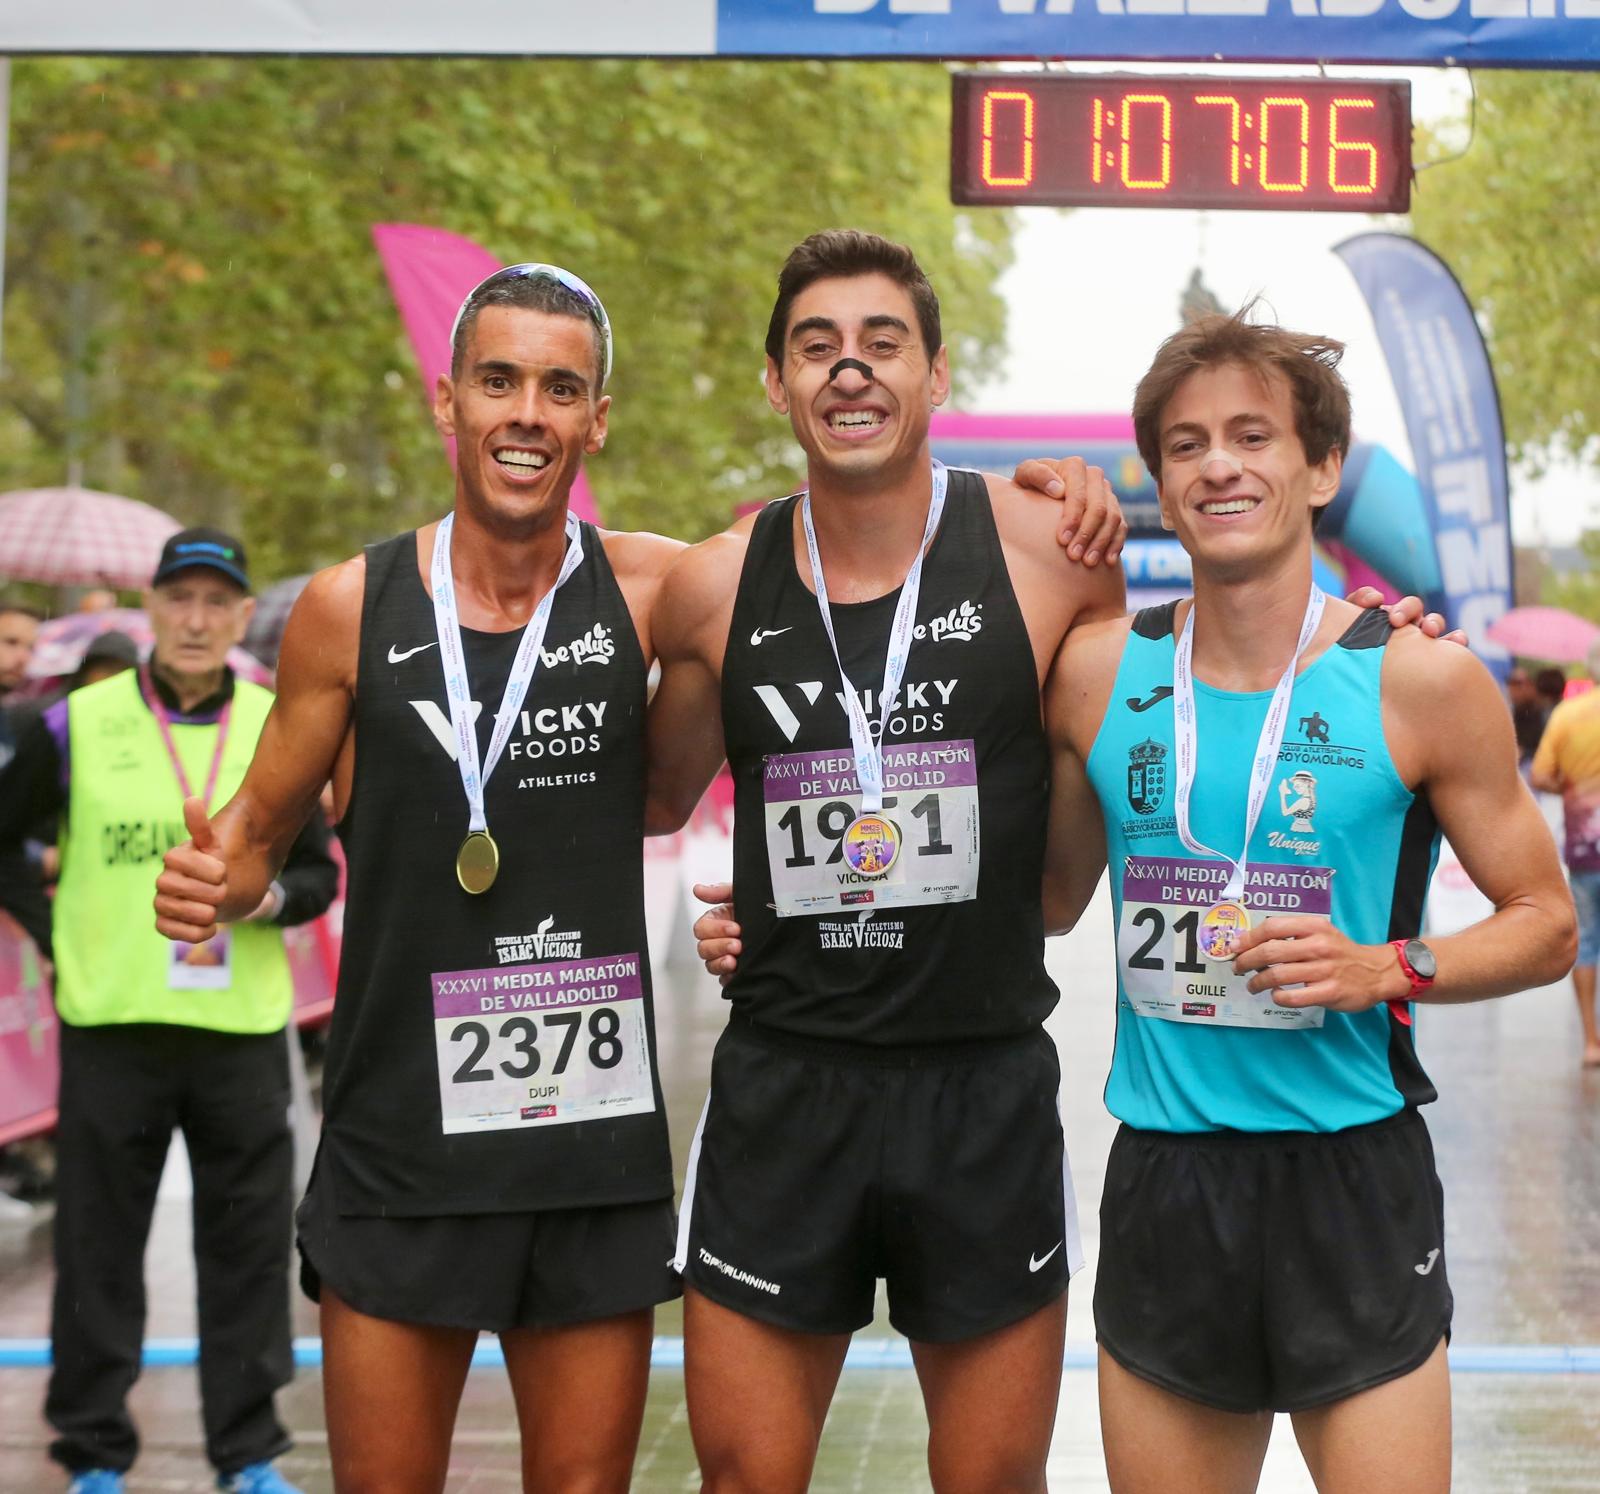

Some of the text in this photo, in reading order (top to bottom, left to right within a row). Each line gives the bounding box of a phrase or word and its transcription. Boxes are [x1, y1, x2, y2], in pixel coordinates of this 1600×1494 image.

[912, 602, 982, 643] e plus
[569, 623, 615, 666] plus
[494, 702, 607, 737] ICKY
[866, 712, 944, 738] OODS
[509, 734, 601, 760] FOODS
[1277, 751, 1365, 769] ROYOMOLINOS
[518, 772, 597, 789] ATHLETICS
[766, 762, 805, 780] XXXVI
[811, 757, 857, 775] MEDI
[799, 769, 946, 796] DE VALDOLID
[778, 793, 953, 868] 191
[1267, 832, 1320, 854] Unique
[1175, 866, 1230, 884] MEDIA
[1162, 886, 1182, 901] DE
[819, 923, 842, 933] ESCUELA
[867, 922, 904, 935] ATLETISMO
[820, 923, 904, 949] ISAAC VICIOSA
[1128, 908, 1207, 974] 21
[496, 933, 582, 964] ISAAC VICIOSA
[437, 960, 636, 996] XXXVI MEDIA MARATÓN
[1186, 983, 1227, 997] GUILLE
[481, 984, 618, 1012] DE VALLADOLID
[450, 1007, 623, 1083] 2378
[529, 1086, 559, 1099] DUPI
